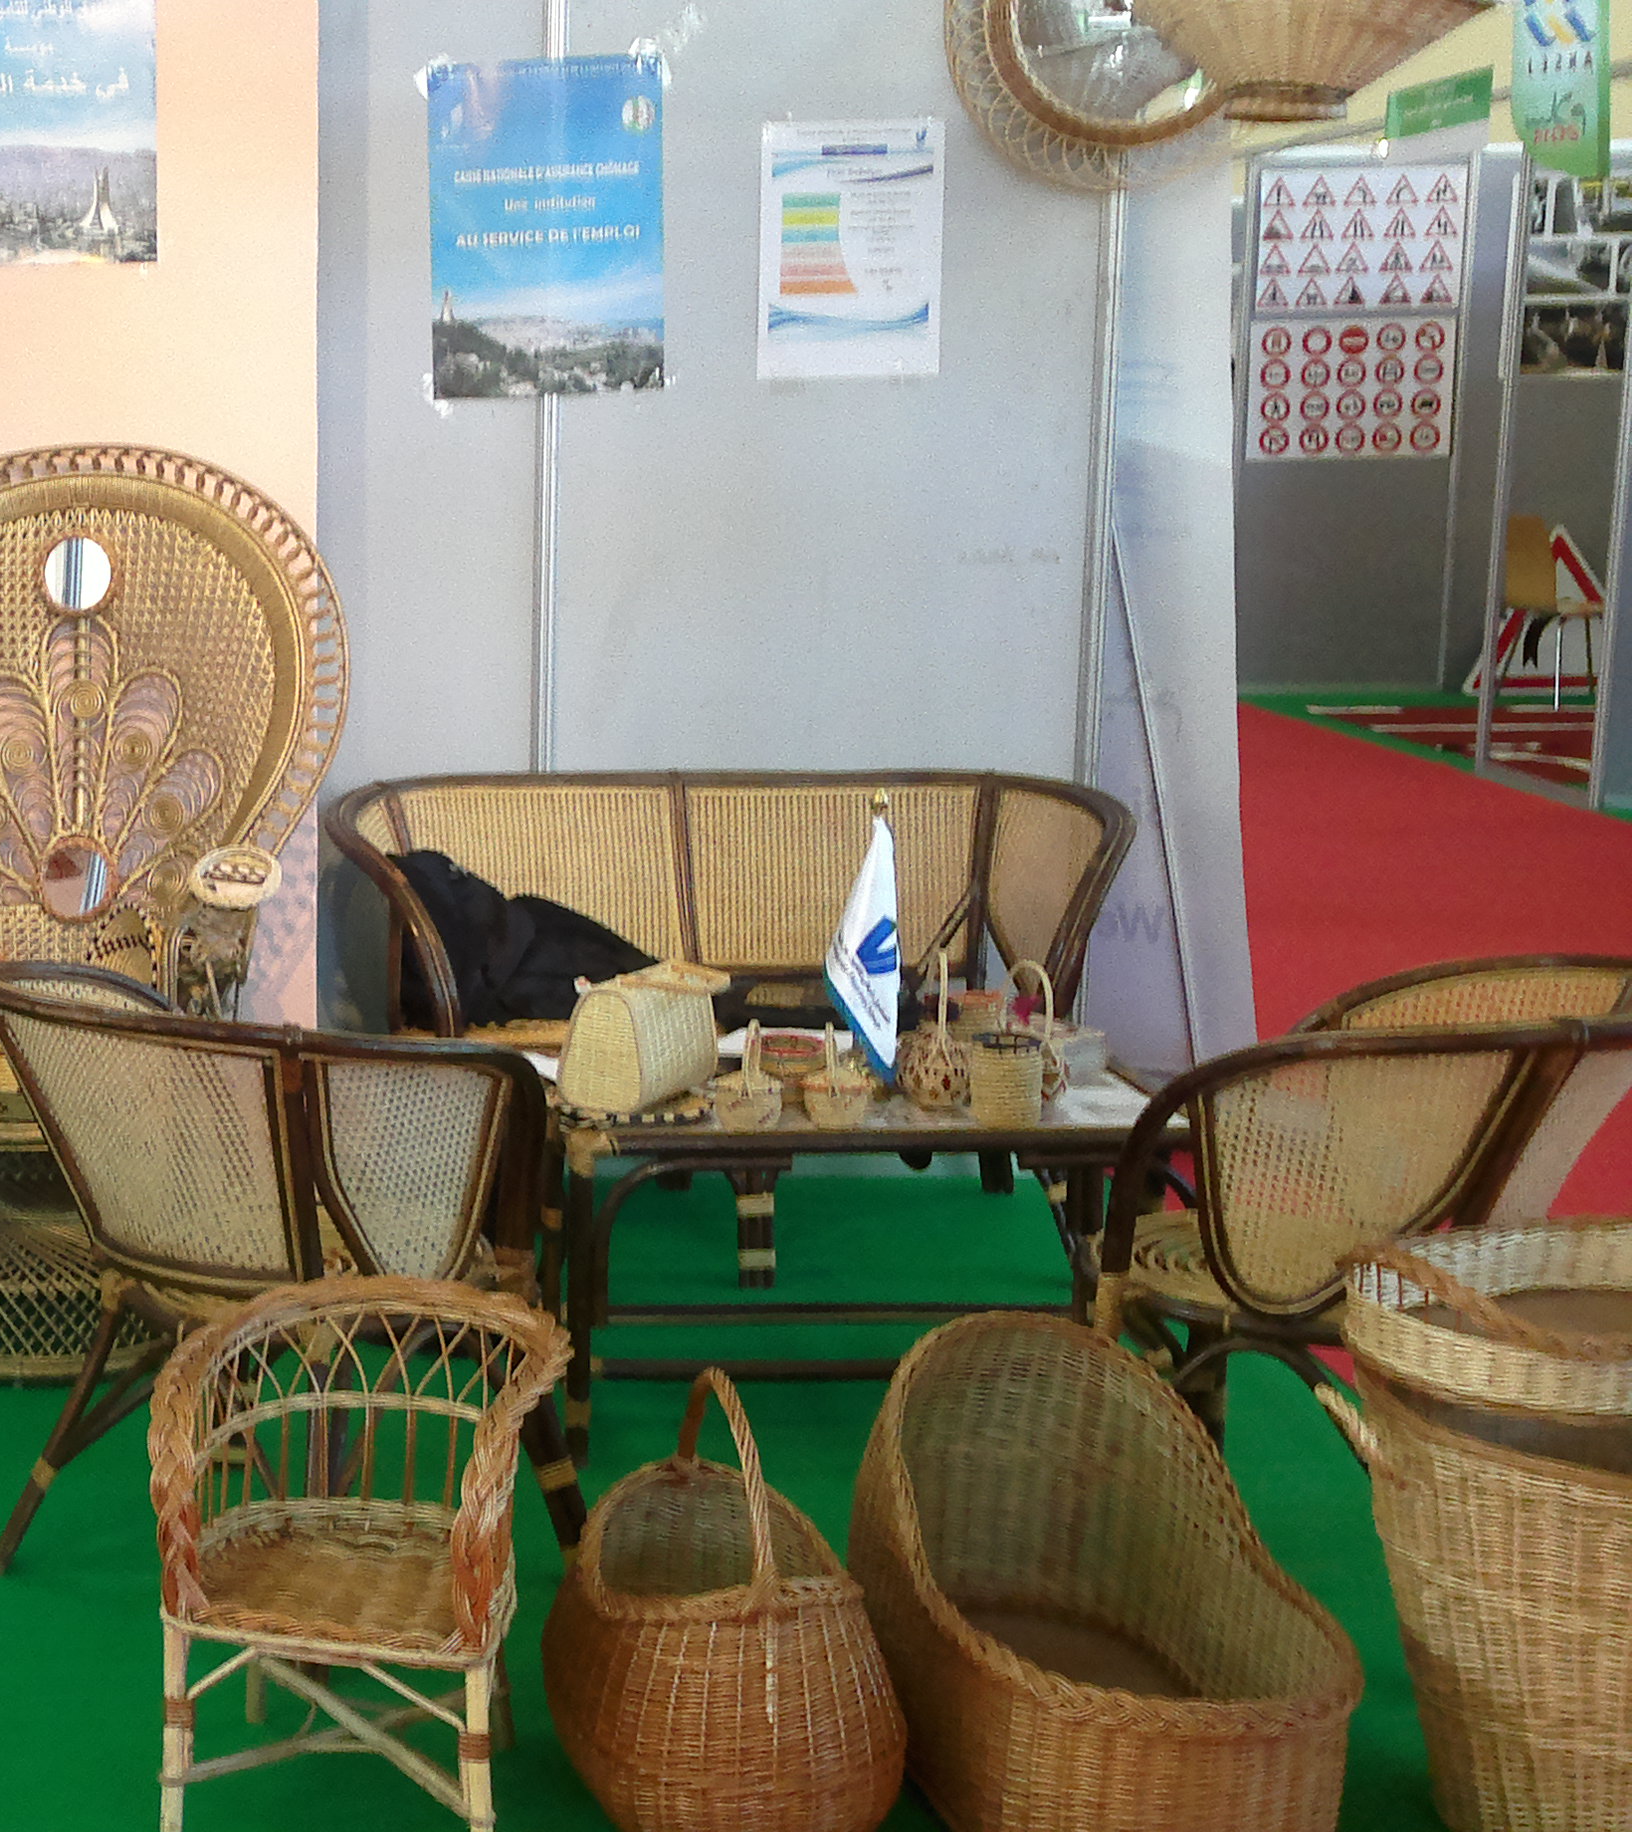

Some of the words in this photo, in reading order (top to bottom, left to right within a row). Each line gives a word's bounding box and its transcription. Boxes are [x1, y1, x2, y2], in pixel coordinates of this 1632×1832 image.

[24, 69, 87, 93] خدمة
[96, 66, 129, 99] في
[483, 166, 534, 182] NATIONALE
[504, 198, 528, 211] Une
[456, 233, 478, 247] AU
[483, 230, 544, 246] SERVICE
[548, 229, 569, 243] DE
[573, 225, 640, 243] L'EMPLOI
